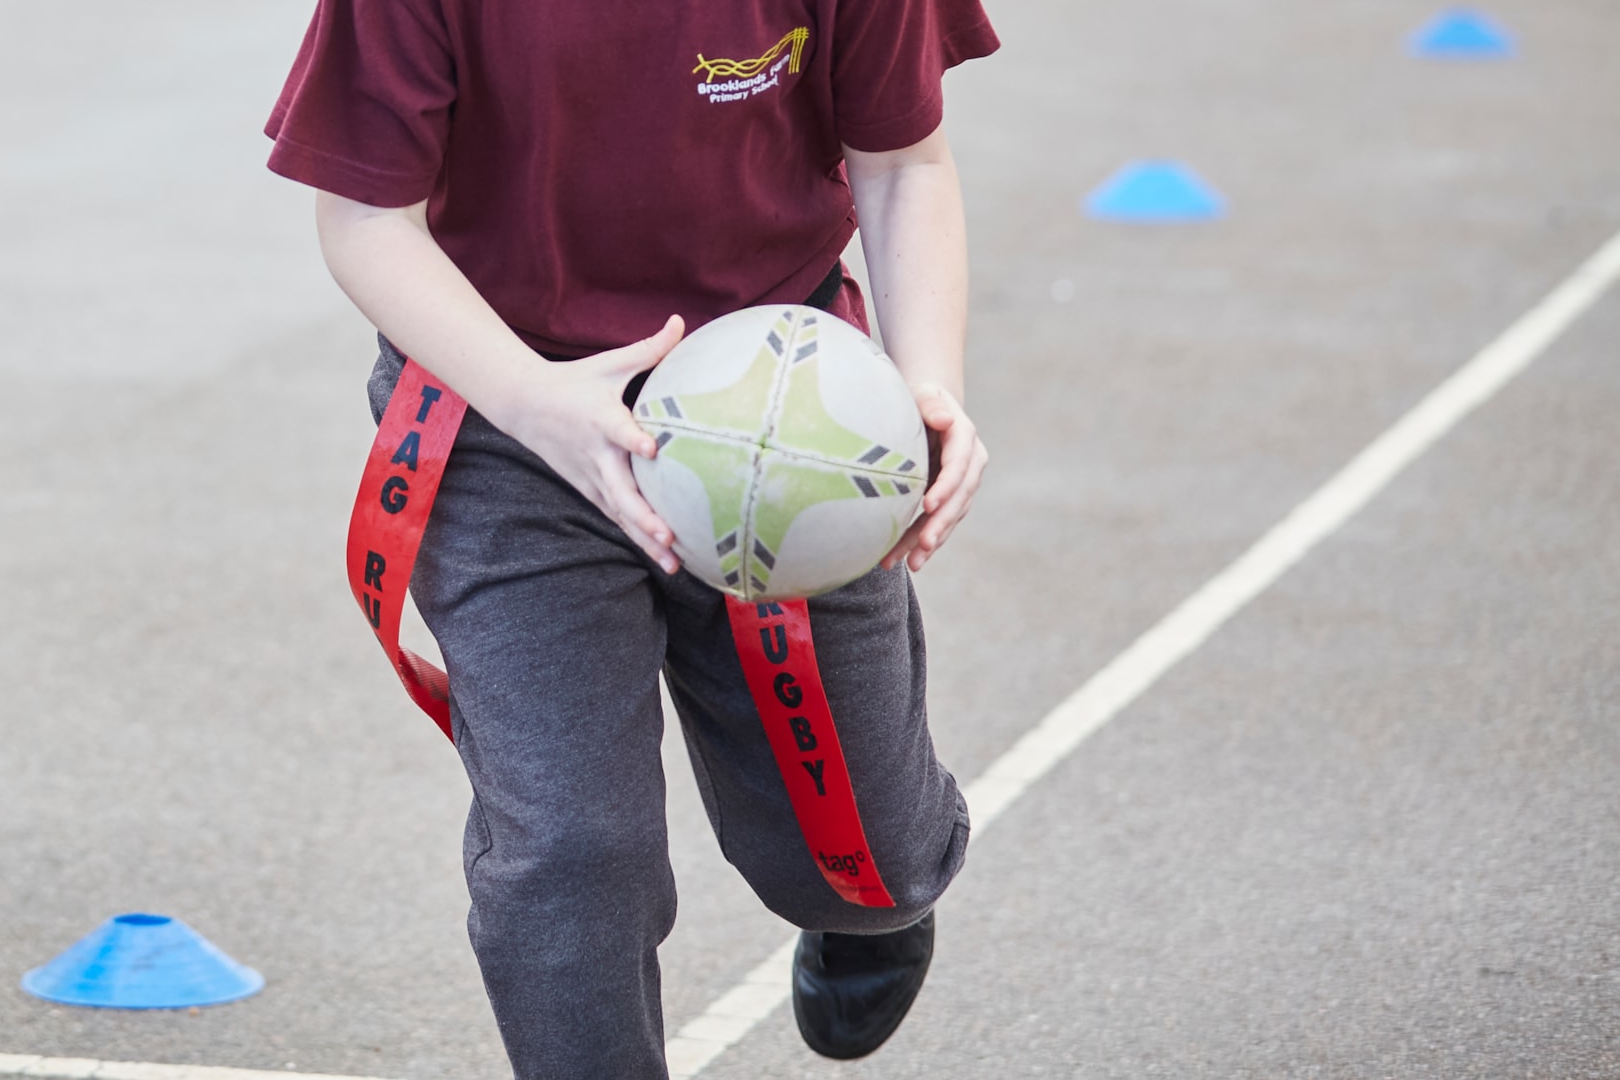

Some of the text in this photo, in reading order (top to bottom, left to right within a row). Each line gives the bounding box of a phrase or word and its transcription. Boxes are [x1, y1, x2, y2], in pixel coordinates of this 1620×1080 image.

[697, 73, 767, 95] Brooklands
[709, 74, 779, 104] Primary School
[380, 385, 442, 515] TAG
